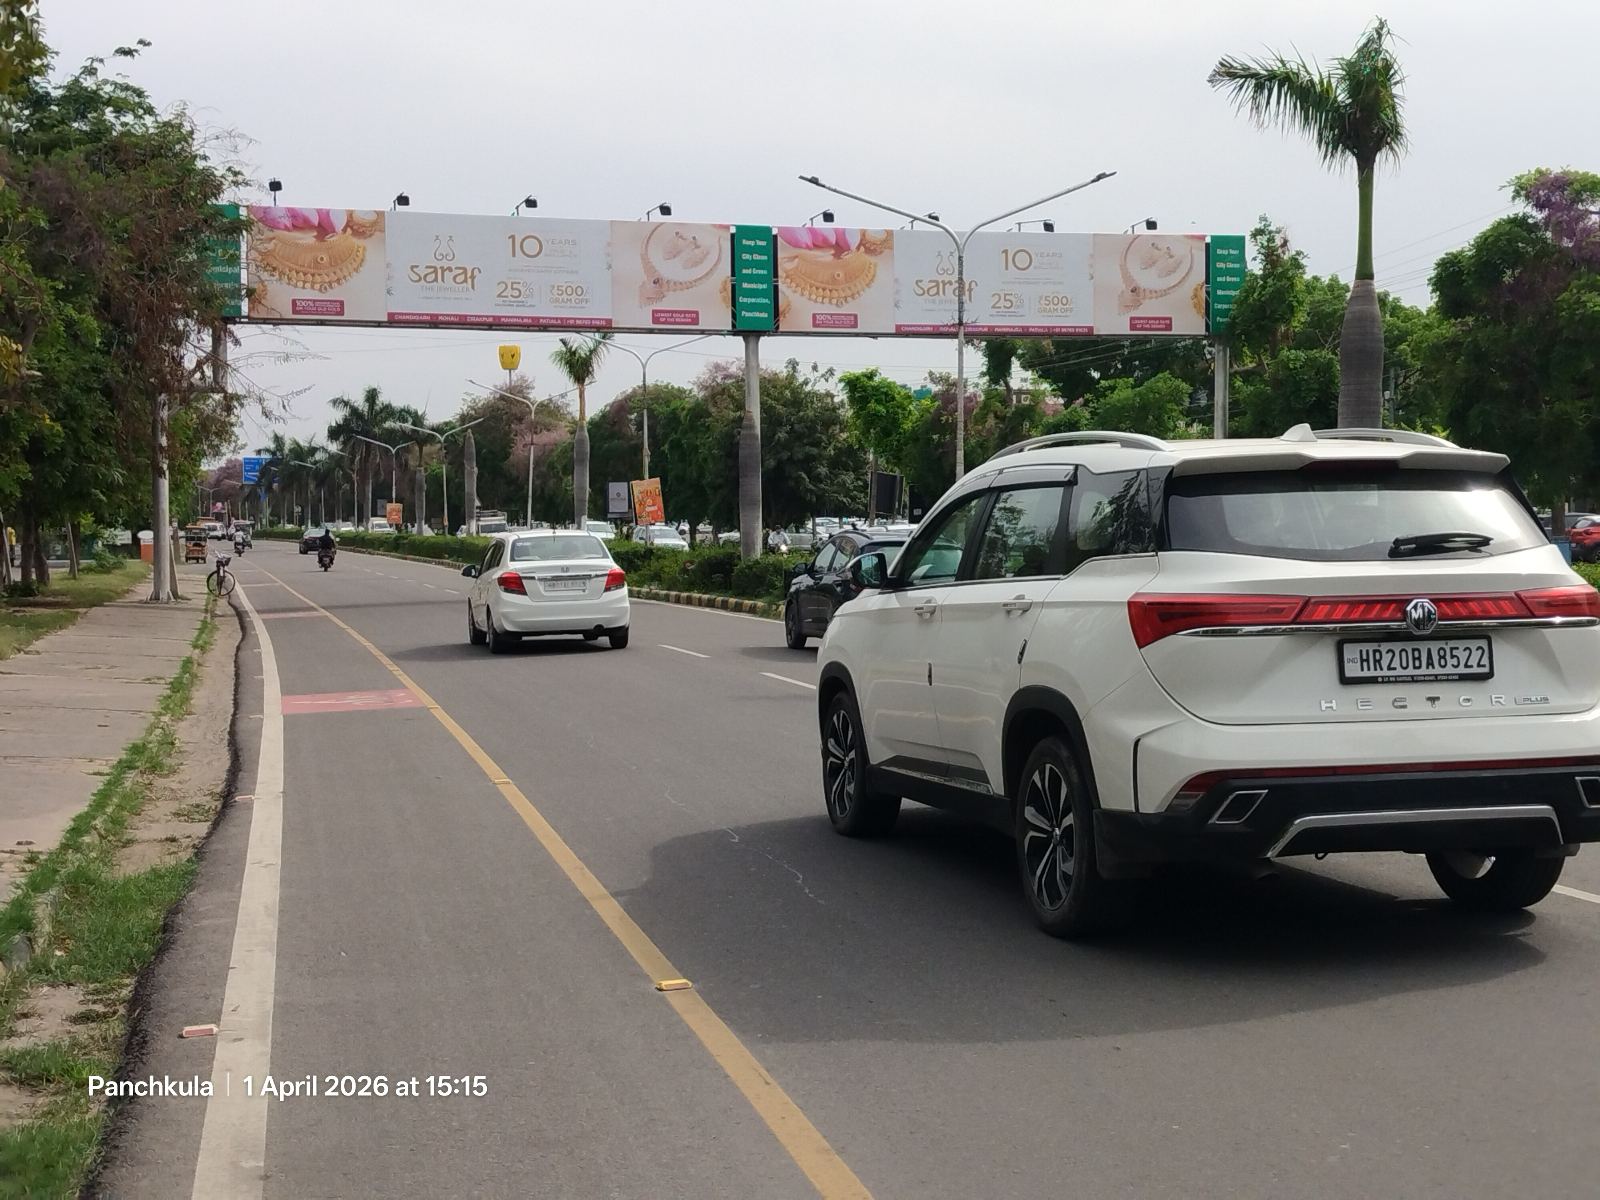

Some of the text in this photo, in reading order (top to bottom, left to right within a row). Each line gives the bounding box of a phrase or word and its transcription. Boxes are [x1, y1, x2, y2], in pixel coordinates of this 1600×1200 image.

[508, 233, 543, 259] 10
[1001, 248, 1033, 271] 10
[407, 264, 482, 291] saraf
[742, 281, 768, 290] Municipal
[1359, 645, 1487, 673] HR20BA8522
[1319, 694, 1506, 712] HECTOR
